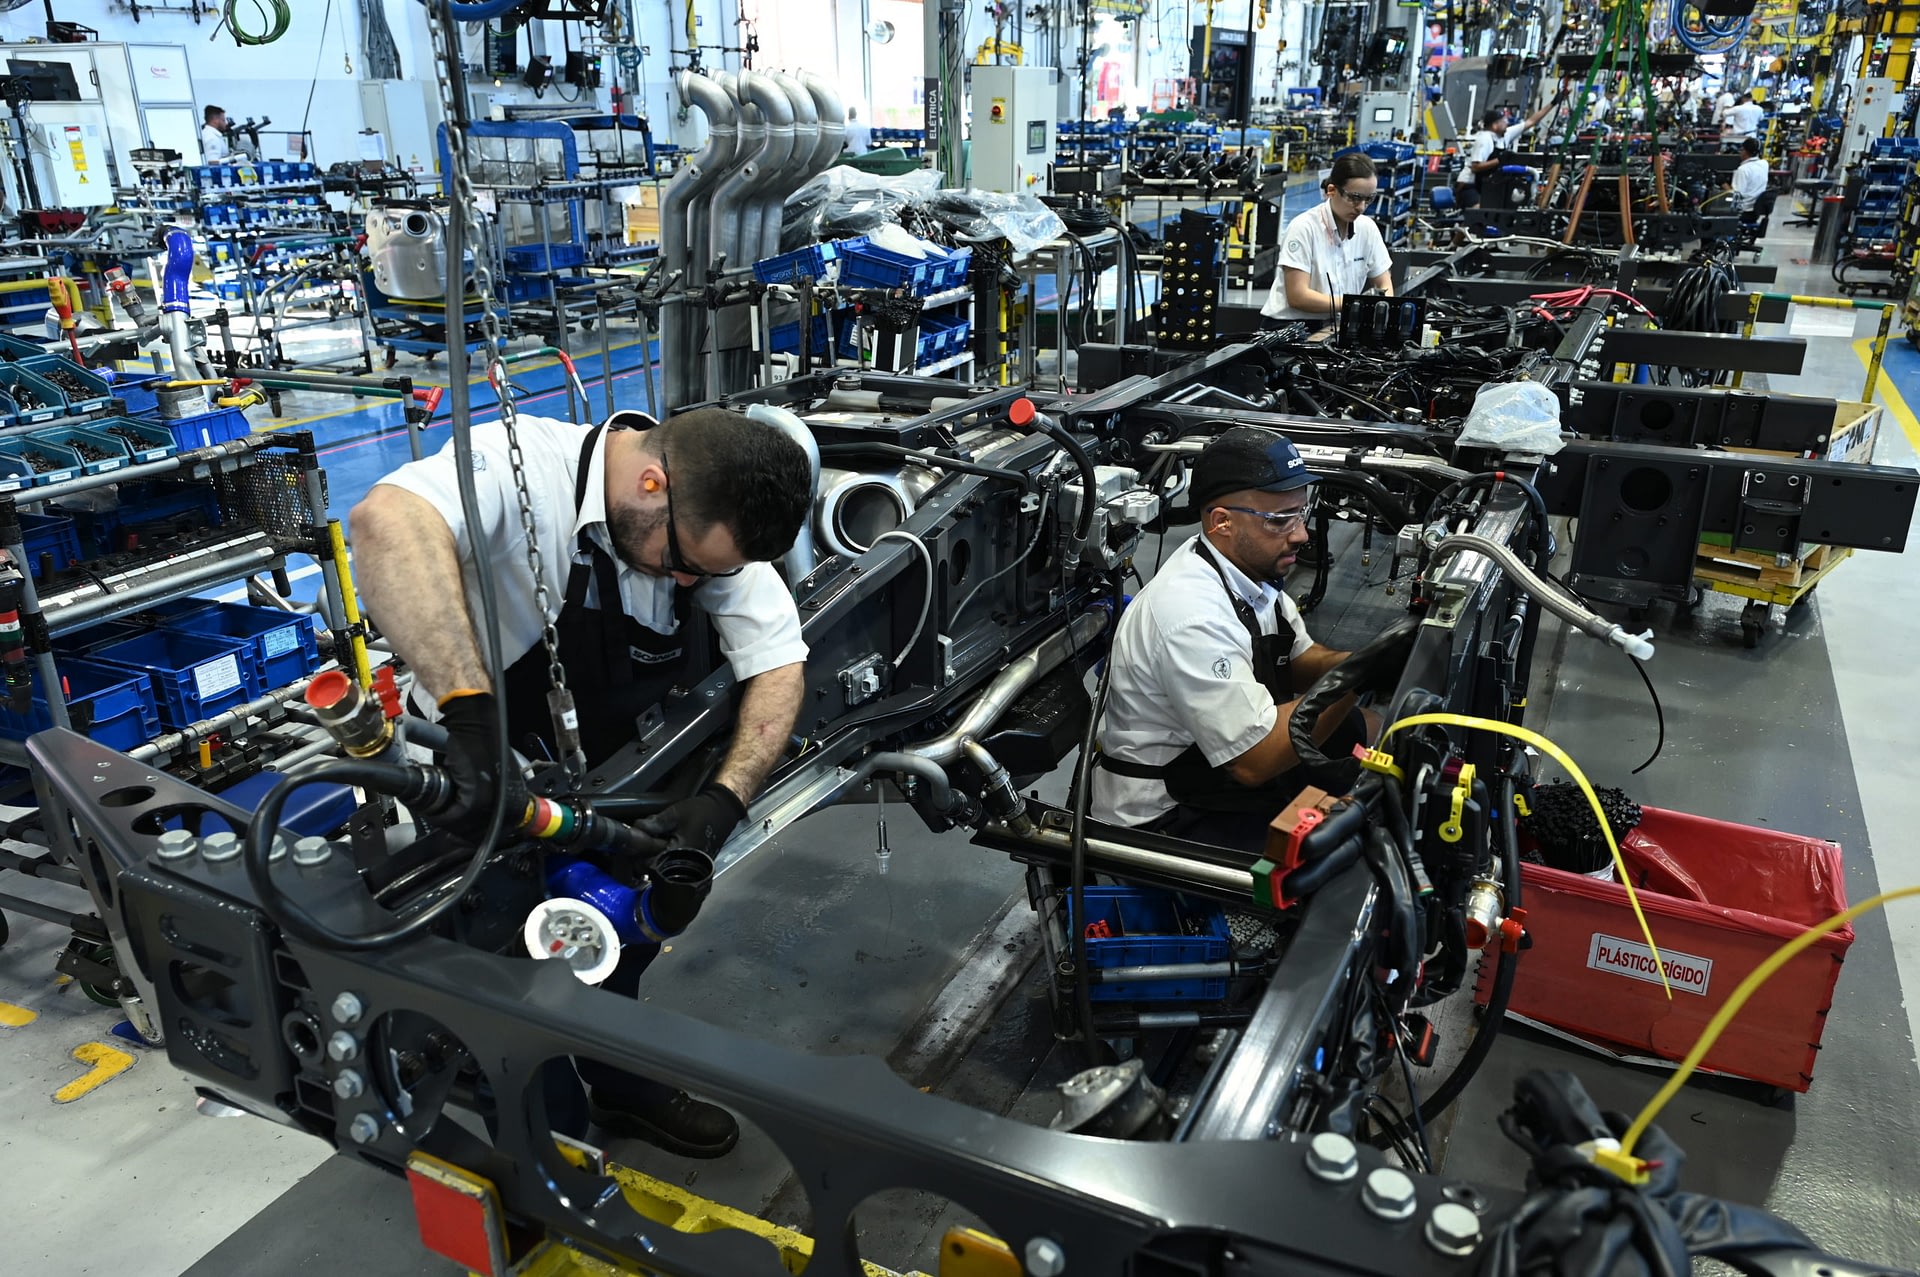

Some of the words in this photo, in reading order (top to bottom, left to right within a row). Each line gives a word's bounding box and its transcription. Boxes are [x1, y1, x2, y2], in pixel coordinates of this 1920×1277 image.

[928, 89, 937, 139] ELÉTRICA
[1598, 946, 1658, 974] PLÁSTICO
[1659, 960, 1704, 985] RÍGIDO
